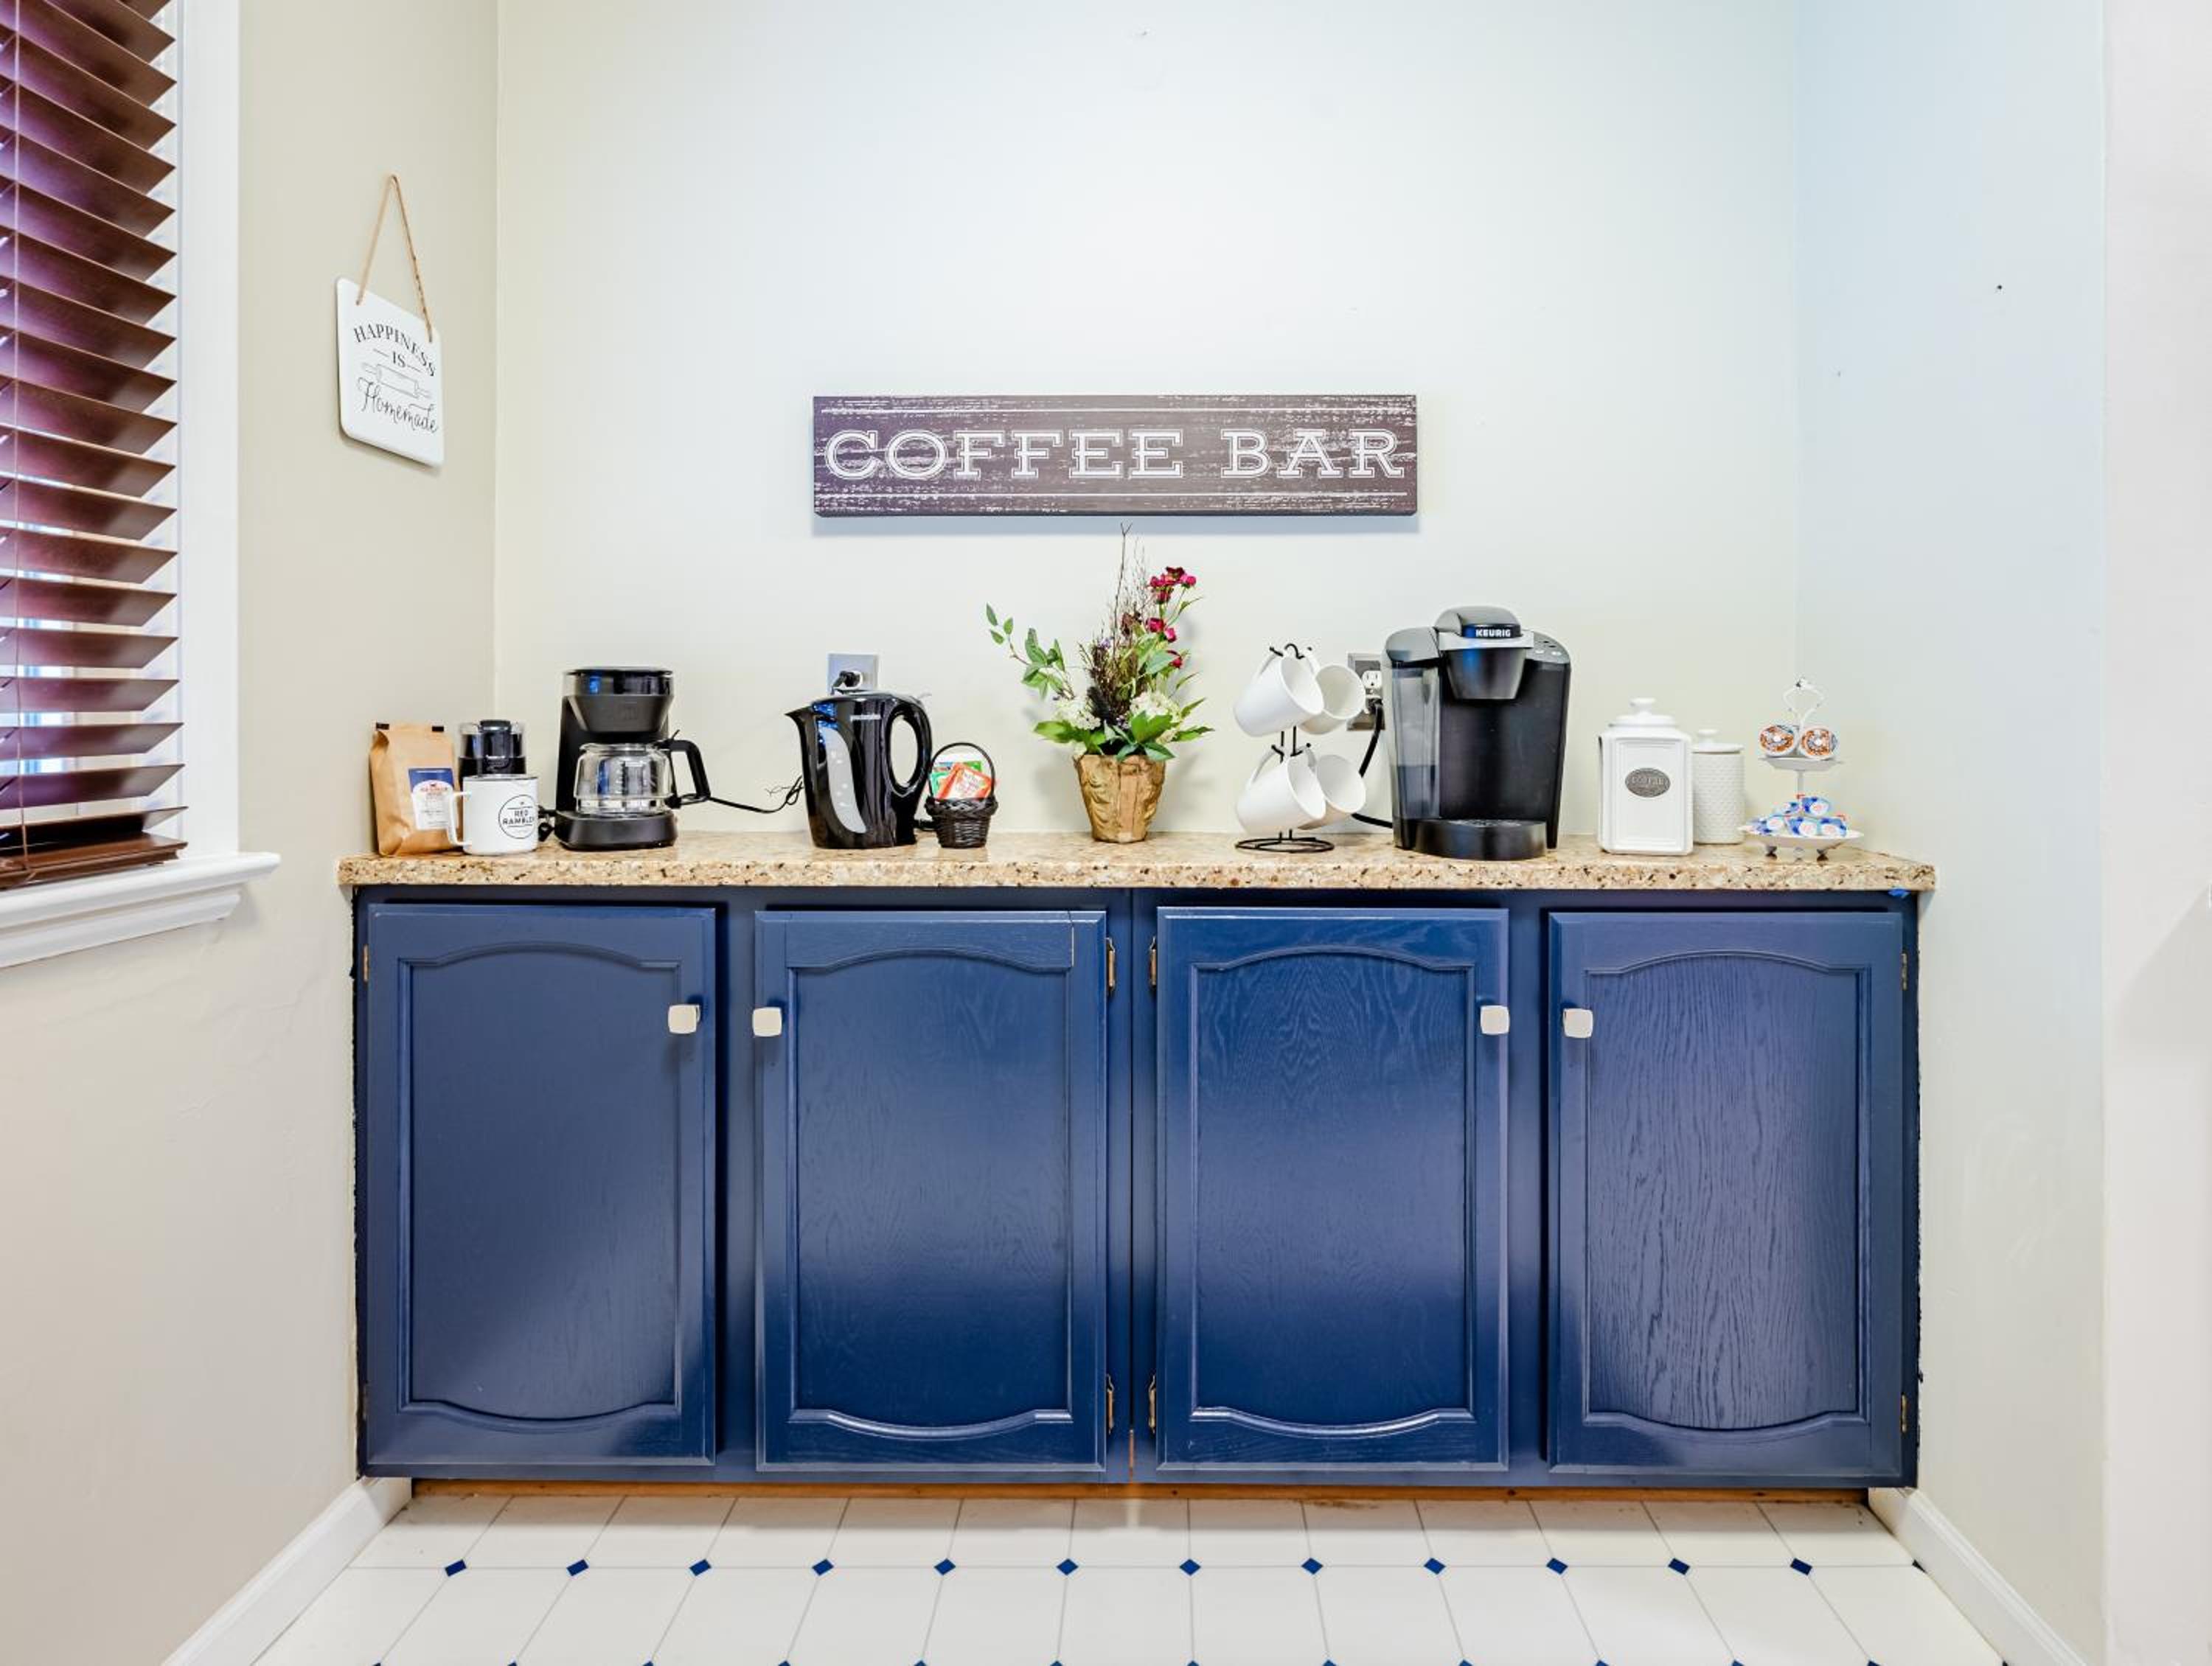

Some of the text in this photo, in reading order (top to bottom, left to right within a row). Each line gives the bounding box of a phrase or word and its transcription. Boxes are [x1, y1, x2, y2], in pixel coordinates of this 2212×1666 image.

[353, 323, 436, 377] HAPPINESS
[392, 351, 406, 369] IS
[358, 377, 437, 433] Homemade
[824, 429, 1405, 478] COFFEE BAR
[1475, 628, 1511, 638] KEURIG
